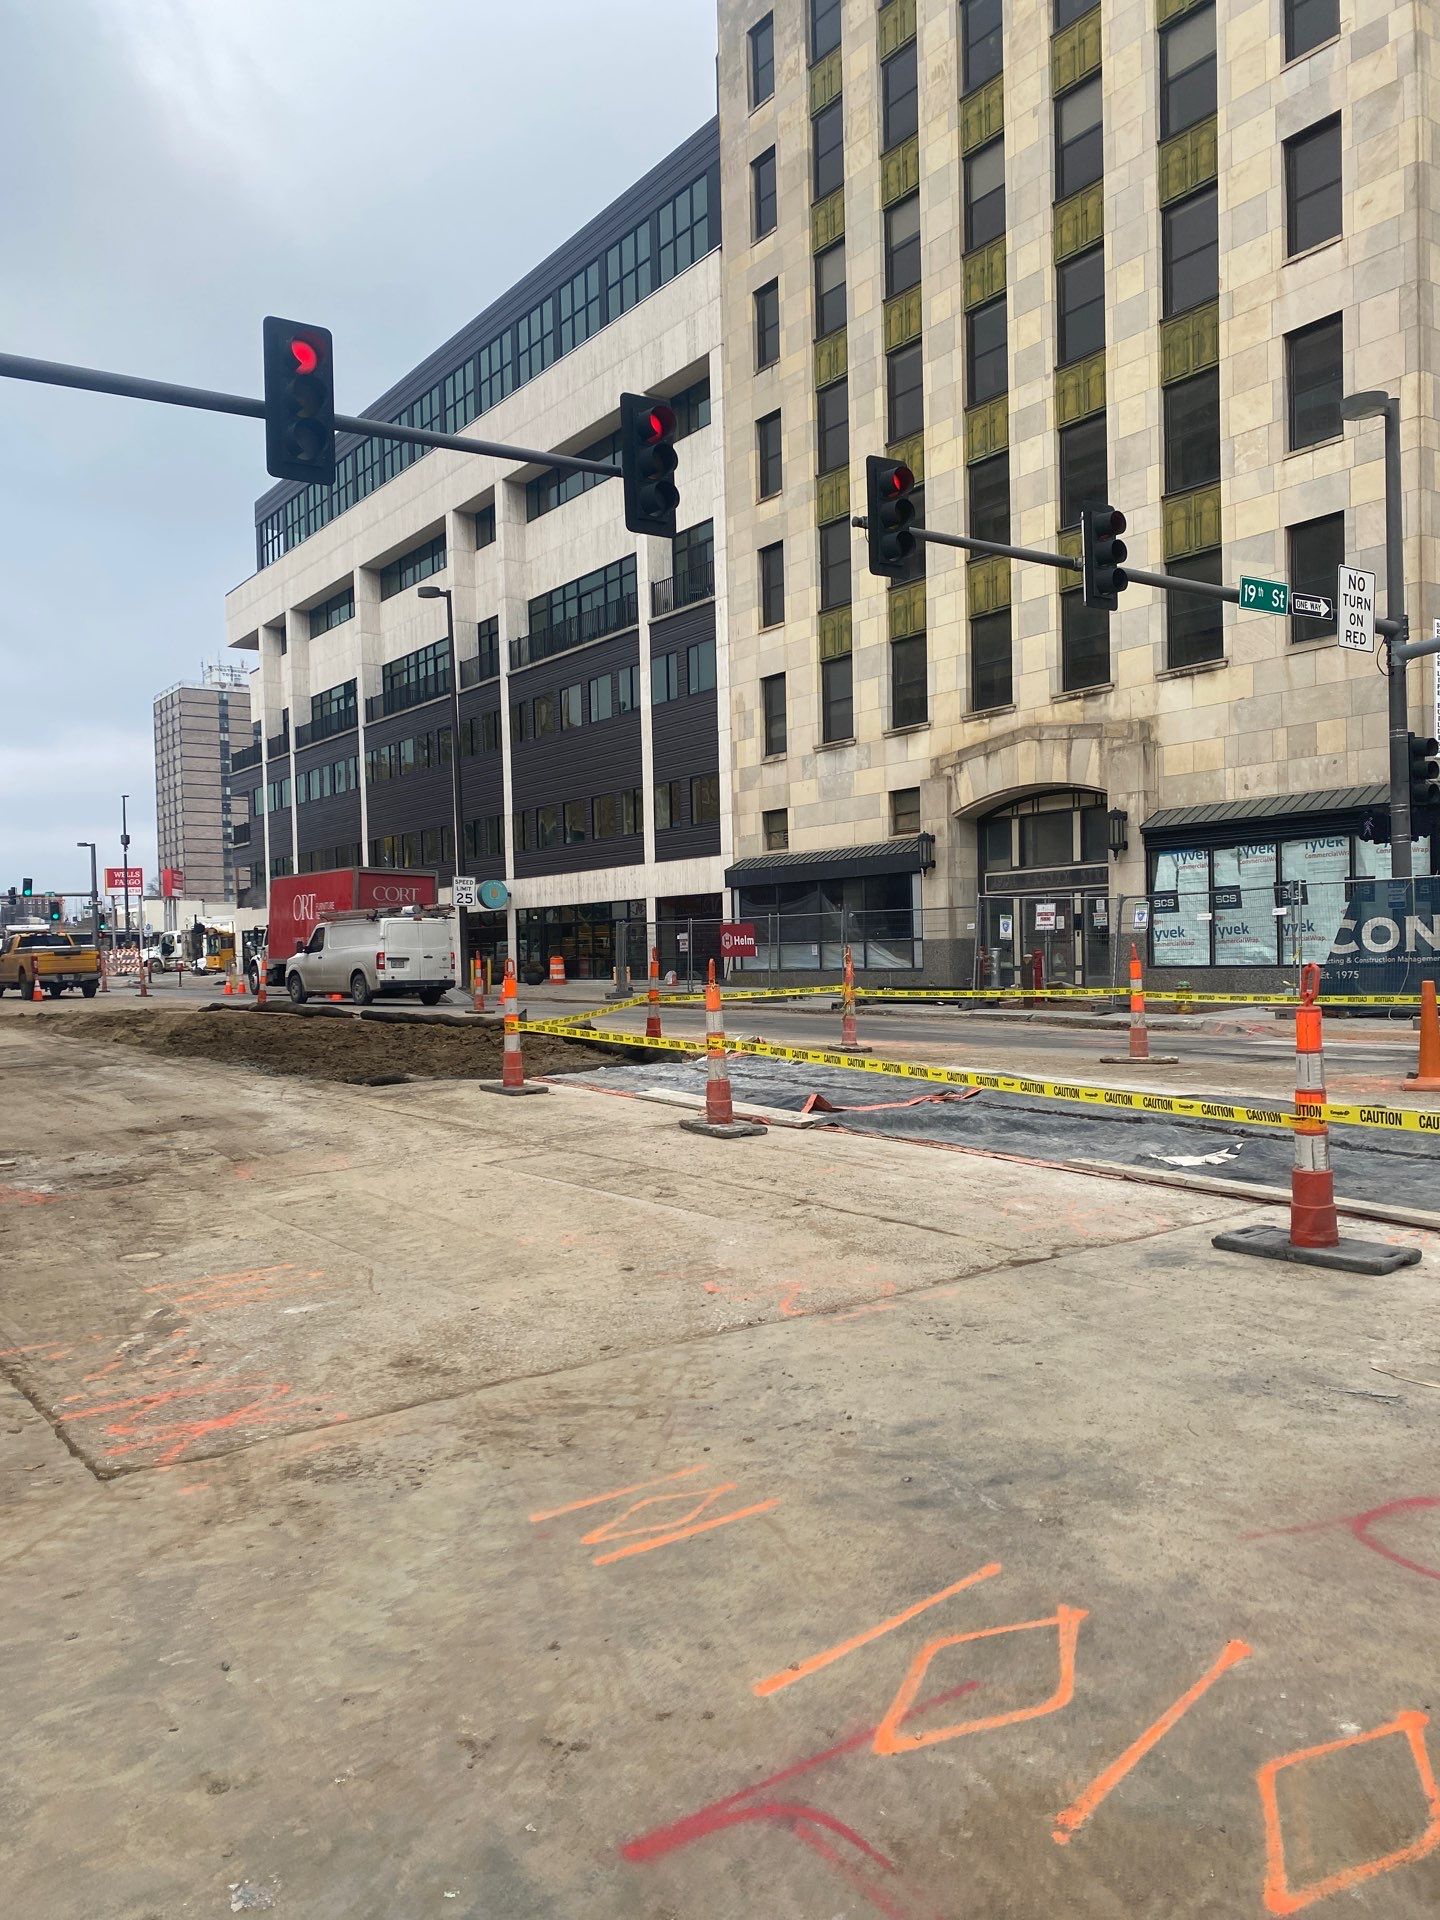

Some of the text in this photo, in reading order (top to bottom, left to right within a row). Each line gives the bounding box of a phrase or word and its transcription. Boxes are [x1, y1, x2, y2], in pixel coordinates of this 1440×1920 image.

[1349, 574, 1365, 592] NO
[1244, 584, 1285, 608] 19th St
[1343, 593, 1371, 611] TURN
[1296, 601, 1321, 611] ONE WAY
[1349, 613, 1363, 627] ON
[1345, 629, 1366, 645] RED
[1240, 843, 1276, 858] yvek
[373, 886, 420, 902] CORT
[457, 892, 473, 904] 25
[1216, 894, 1237, 903] SCS
[1282, 890, 1302, 899] SS
[1154, 898, 1175, 908] SCS
[1283, 919, 1315, 934] yvek
[734, 935, 755, 946] Helm
[1355, 955, 1396, 964] Construction
[1336, 971, 1360, 979] 1975
[741, 1042, 757, 1052] CAUTION
[770, 1046, 786, 1057] CAUTION
[792, 1049, 808, 1060] CAUTION
[824, 1054, 841, 1064] CAUTION
[847, 1057, 865, 1068] CAUTION
[882, 1062, 901, 1074] CAUTION
[908, 1066, 928, 1078] CAUTION
[947, 1071, 968, 1083] CAUTION
[976, 1075, 999, 1088] CAUTION
[1020, 1081, 1045, 1094] CAUTION
[1053, 1085, 1080, 1099] CAUTION
[1104, 1092, 1133, 1106] CAUTION
[1143, 1096, 1173, 1111] CAUTION
[1201, 1103, 1234, 1118] CAUTION
[1246, 1109, 1282, 1123] CAUTION
[1297, 1104, 1321, 1118] UTION
[1360, 1109, 1402, 1126] CAUTION
